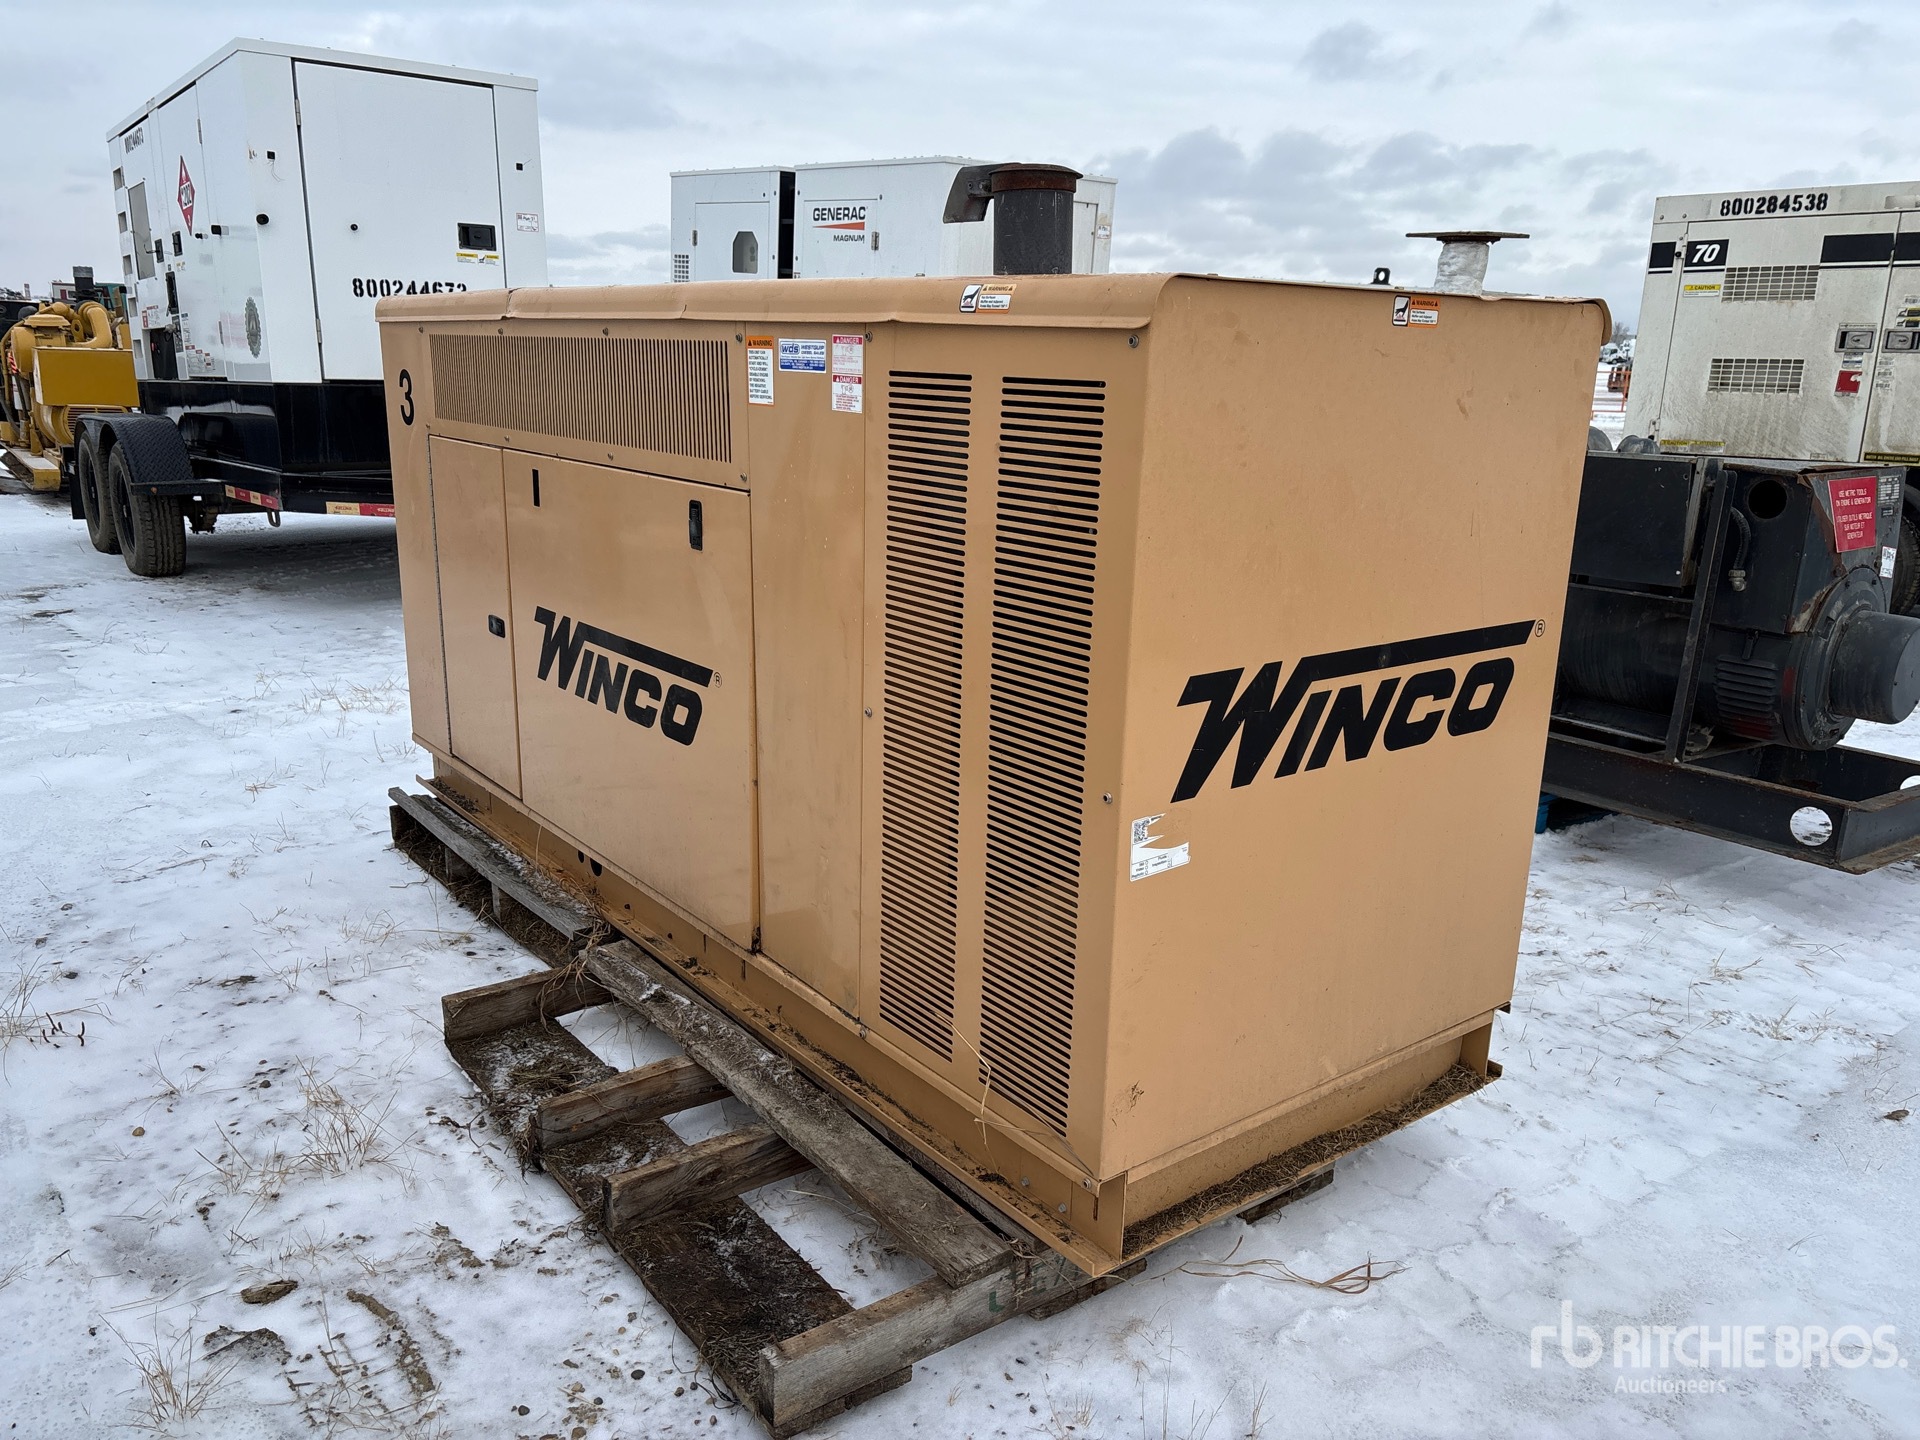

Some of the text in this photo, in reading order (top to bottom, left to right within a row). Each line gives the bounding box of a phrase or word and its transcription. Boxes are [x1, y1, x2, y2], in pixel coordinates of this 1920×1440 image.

[1719, 193, 1829, 217] 800284538
[812, 206, 866, 221] GENERAC
[833, 234, 865, 242] MAGNUM
[1691, 243, 1721, 263] 70
[781, 342, 799, 353] wds
[840, 336, 860, 344] DANGER
[840, 376, 859, 384] DANGER
[399, 368, 415, 426] 3
[1845, 489, 1856, 497] METRIC
[1857, 488, 1867, 496] TOOLS
[534, 605, 714, 746] WINCO
[1170, 620, 1536, 803] WINCO
